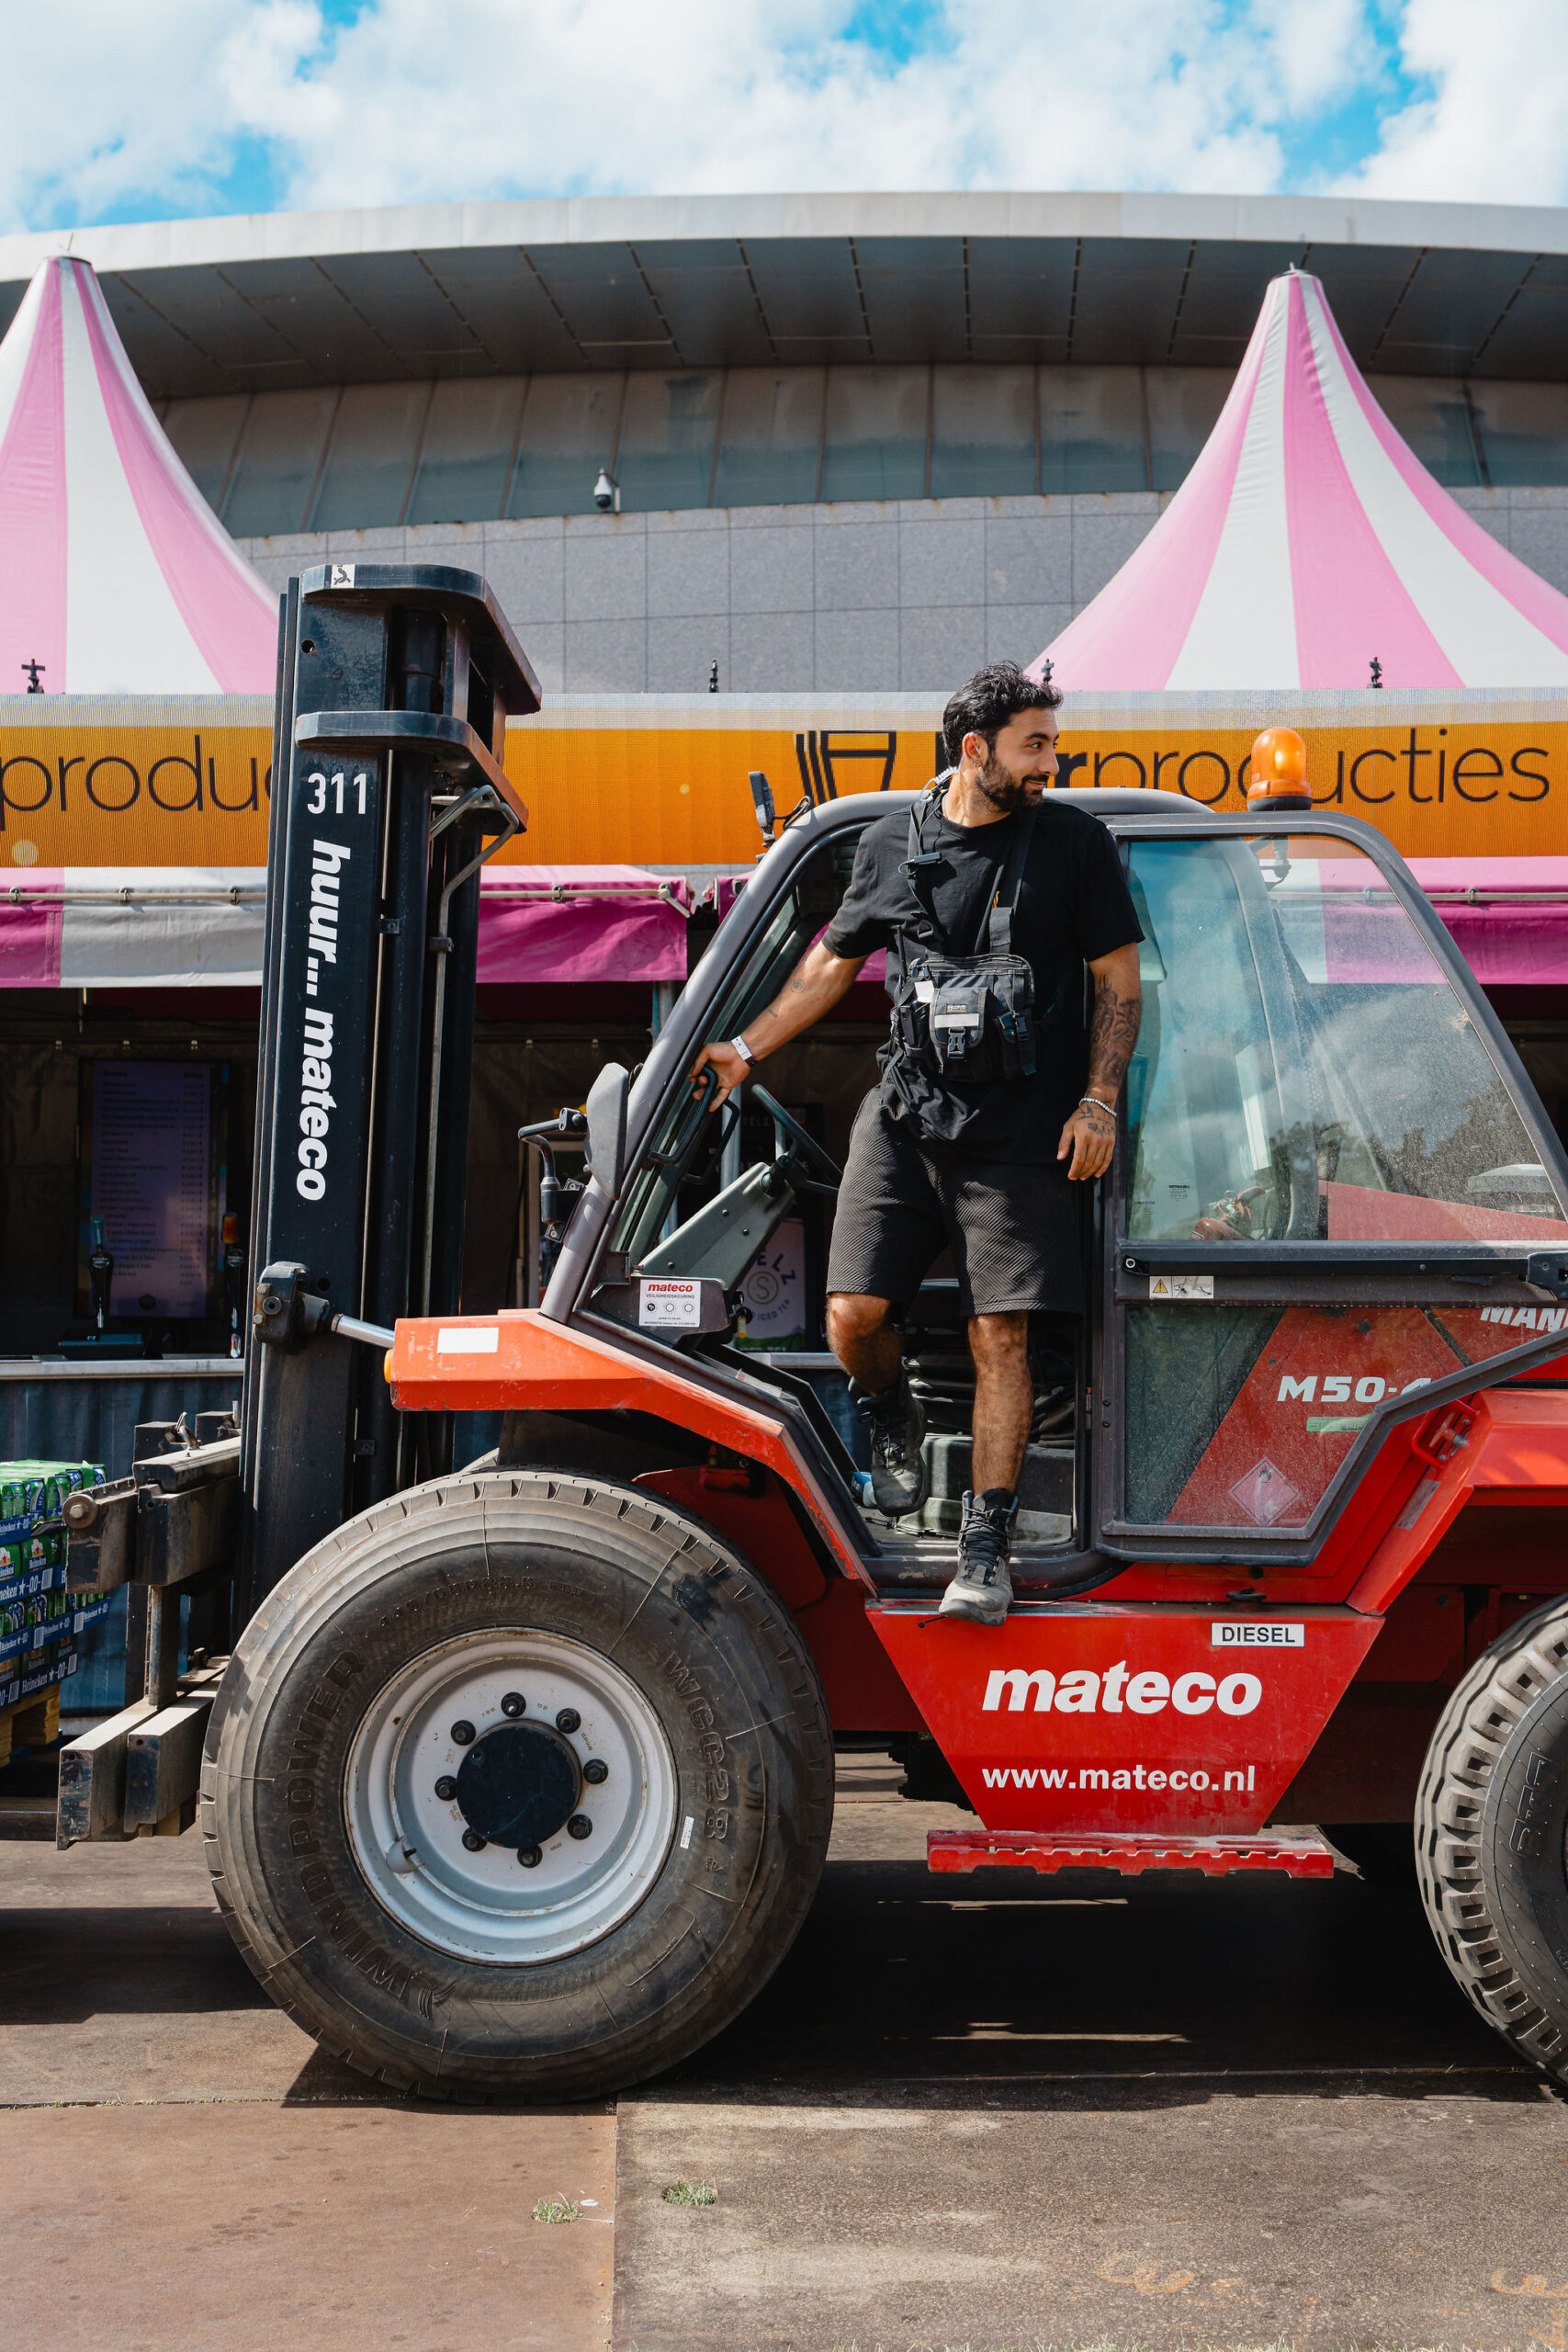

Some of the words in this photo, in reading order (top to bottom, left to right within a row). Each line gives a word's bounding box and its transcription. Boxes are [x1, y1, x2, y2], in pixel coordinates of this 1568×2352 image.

[0, 733, 273, 831] produ
[308, 773, 367, 815] 311
[296, 1008, 336, 1201] mateco
[648, 1283, 694, 1293] mateco
[1222, 1626, 1295, 1643] DIESEL
[981, 1660, 1263, 1716] mateco
[981, 1764, 1255, 1792] www.mateco.nl
